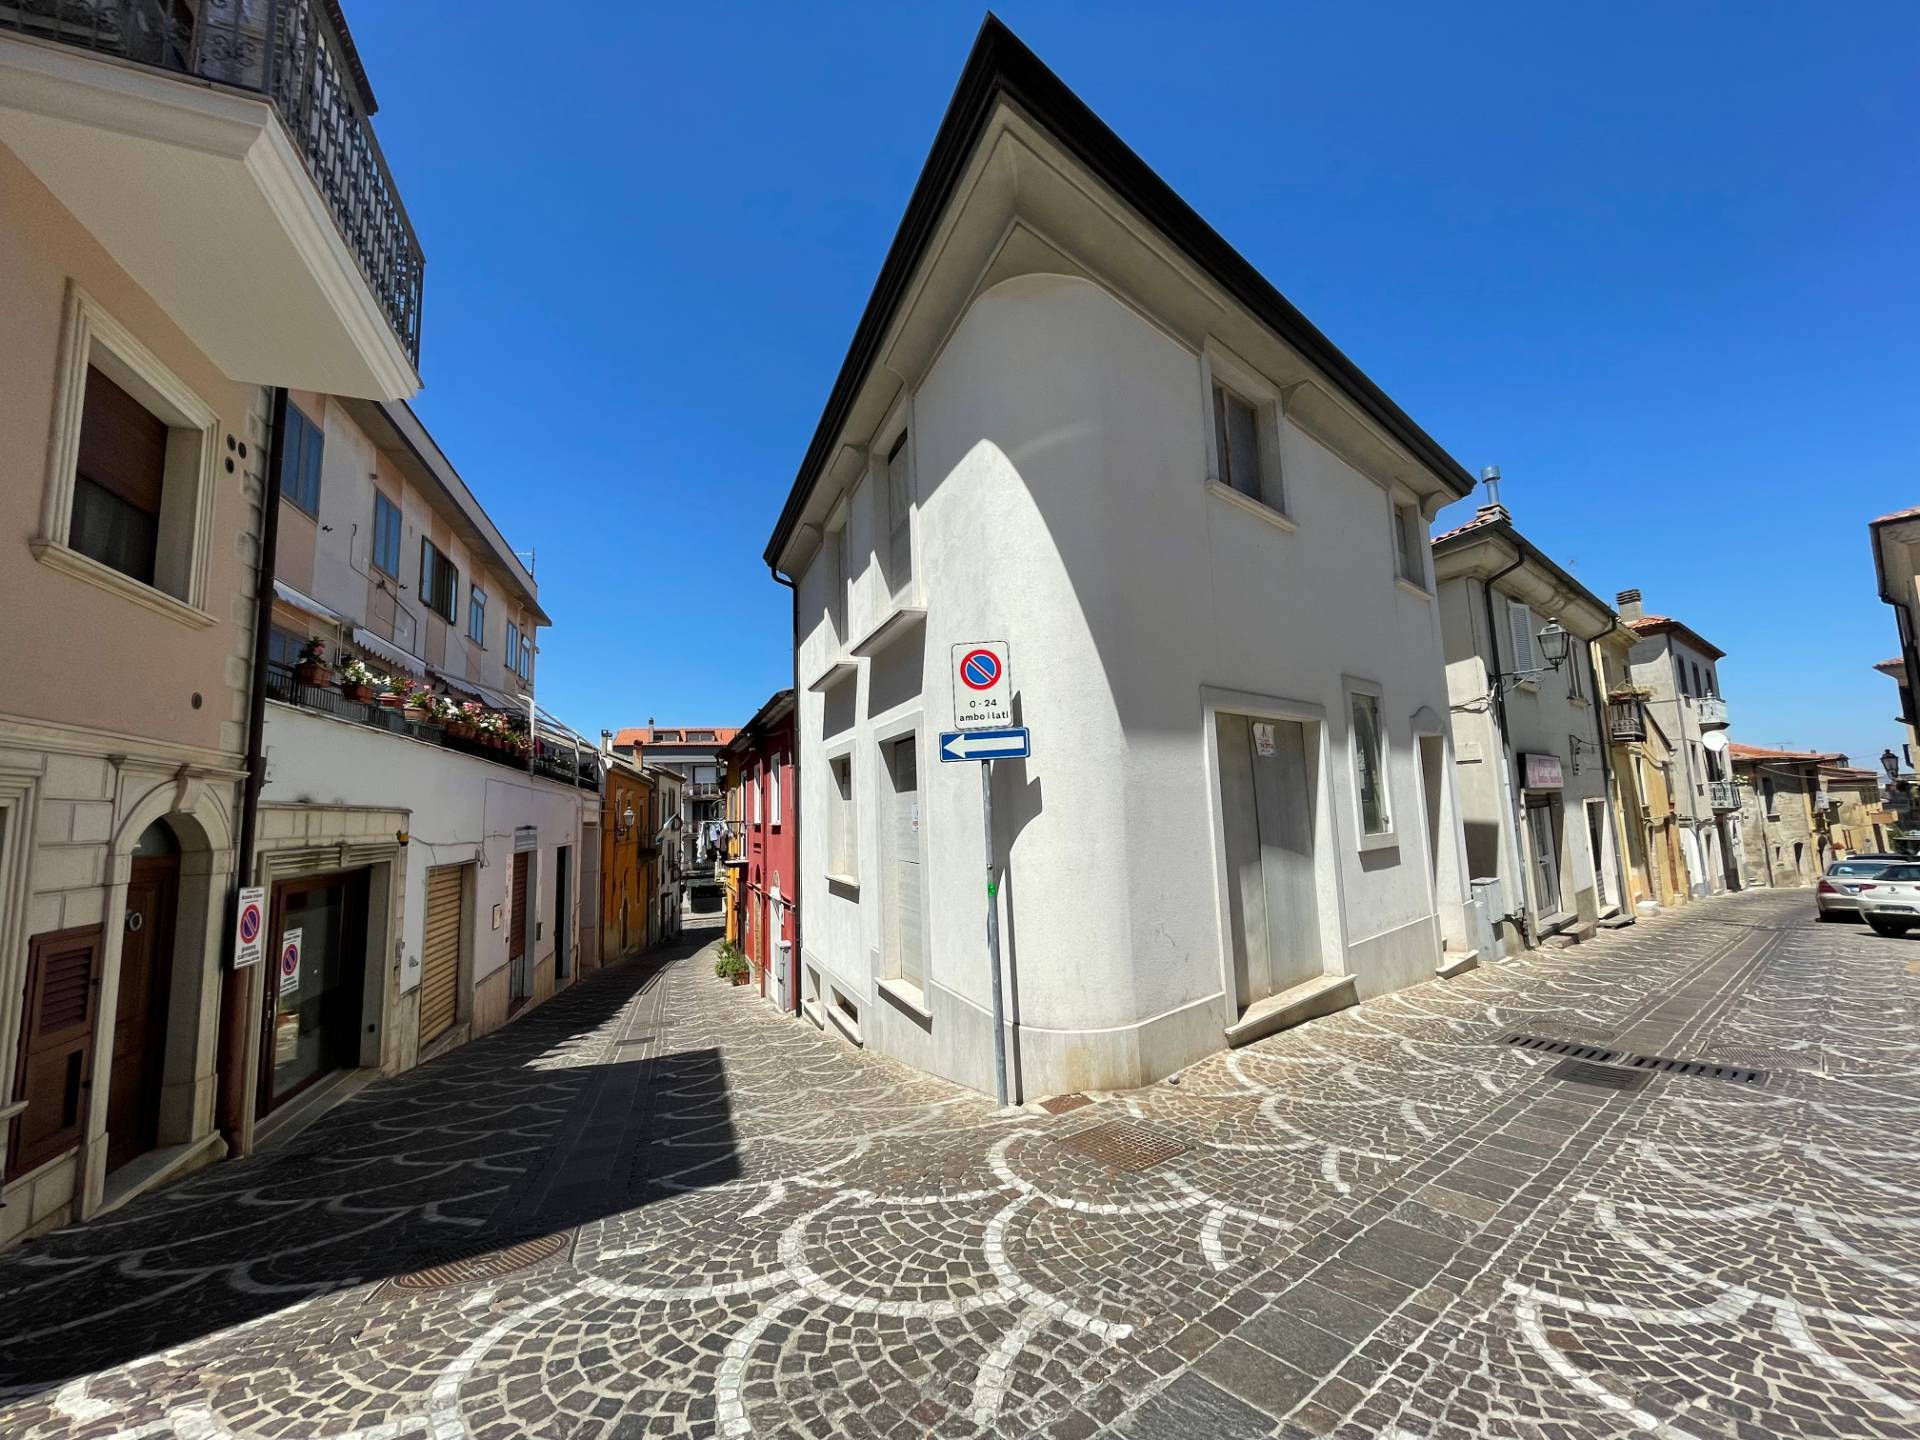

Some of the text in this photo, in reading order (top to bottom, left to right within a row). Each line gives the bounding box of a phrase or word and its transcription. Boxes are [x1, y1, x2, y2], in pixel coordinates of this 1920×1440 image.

[969, 700, 976, 708] 0
[984, 699, 997, 707] 24
[959, 713, 986, 722] ambo
[991, 711, 1009, 719] lati
